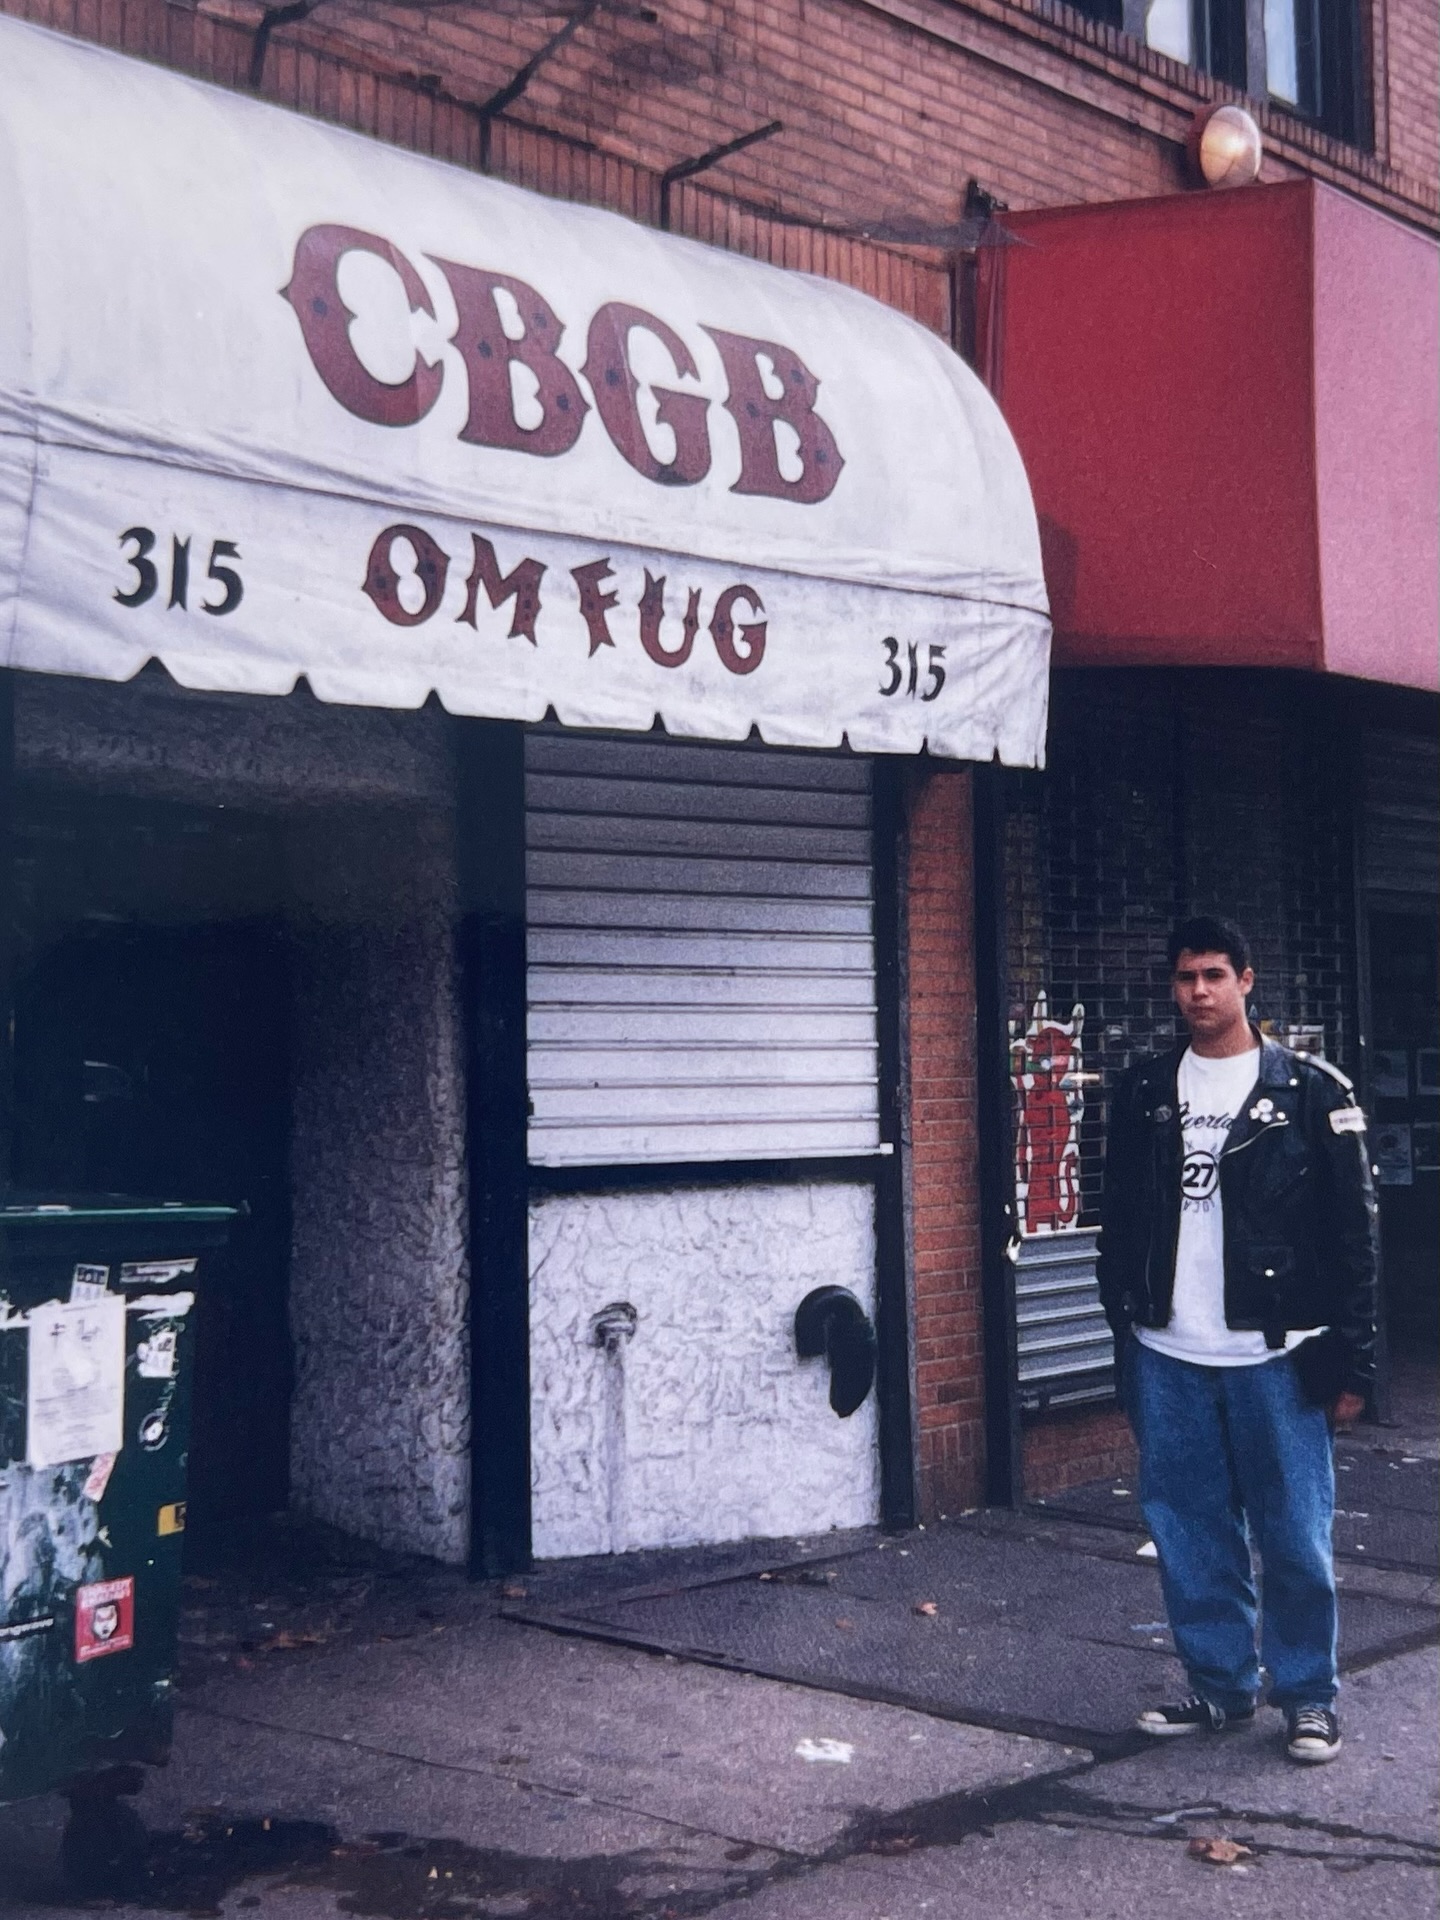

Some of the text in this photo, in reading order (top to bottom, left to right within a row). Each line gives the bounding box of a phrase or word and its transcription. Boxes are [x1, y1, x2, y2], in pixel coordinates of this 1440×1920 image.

[278, 223, 845, 505] CBGB
[113, 524, 947, 702] 315 OMFUG 315
[1182, 1163, 1214, 1188] 27
